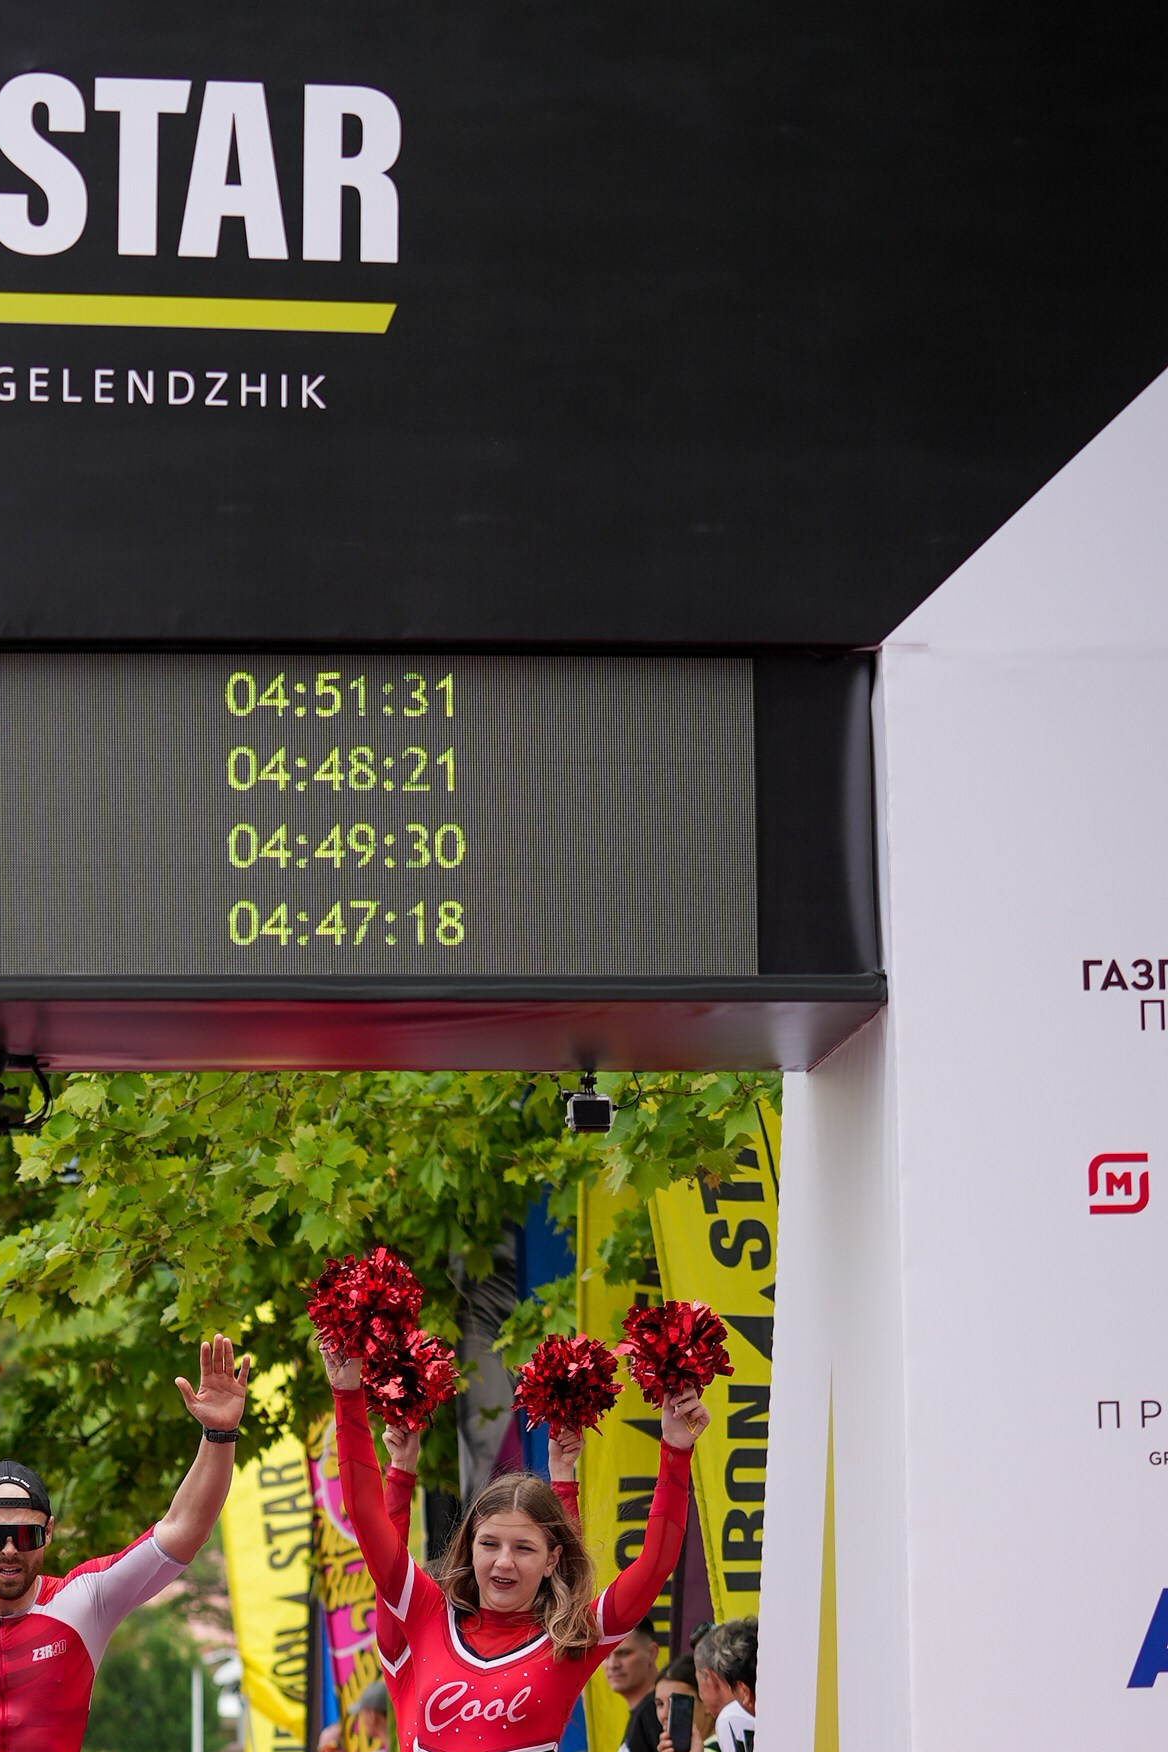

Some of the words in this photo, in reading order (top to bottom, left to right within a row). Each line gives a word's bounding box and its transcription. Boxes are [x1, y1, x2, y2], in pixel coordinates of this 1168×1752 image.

[225, 672, 455, 717] 04:51:31
[227, 746, 456, 791] 04:48:21
[228, 823, 466, 869] 04:49:30
[229, 900, 466, 946] 04:47:18
[424, 1680, 532, 1733] Cool
